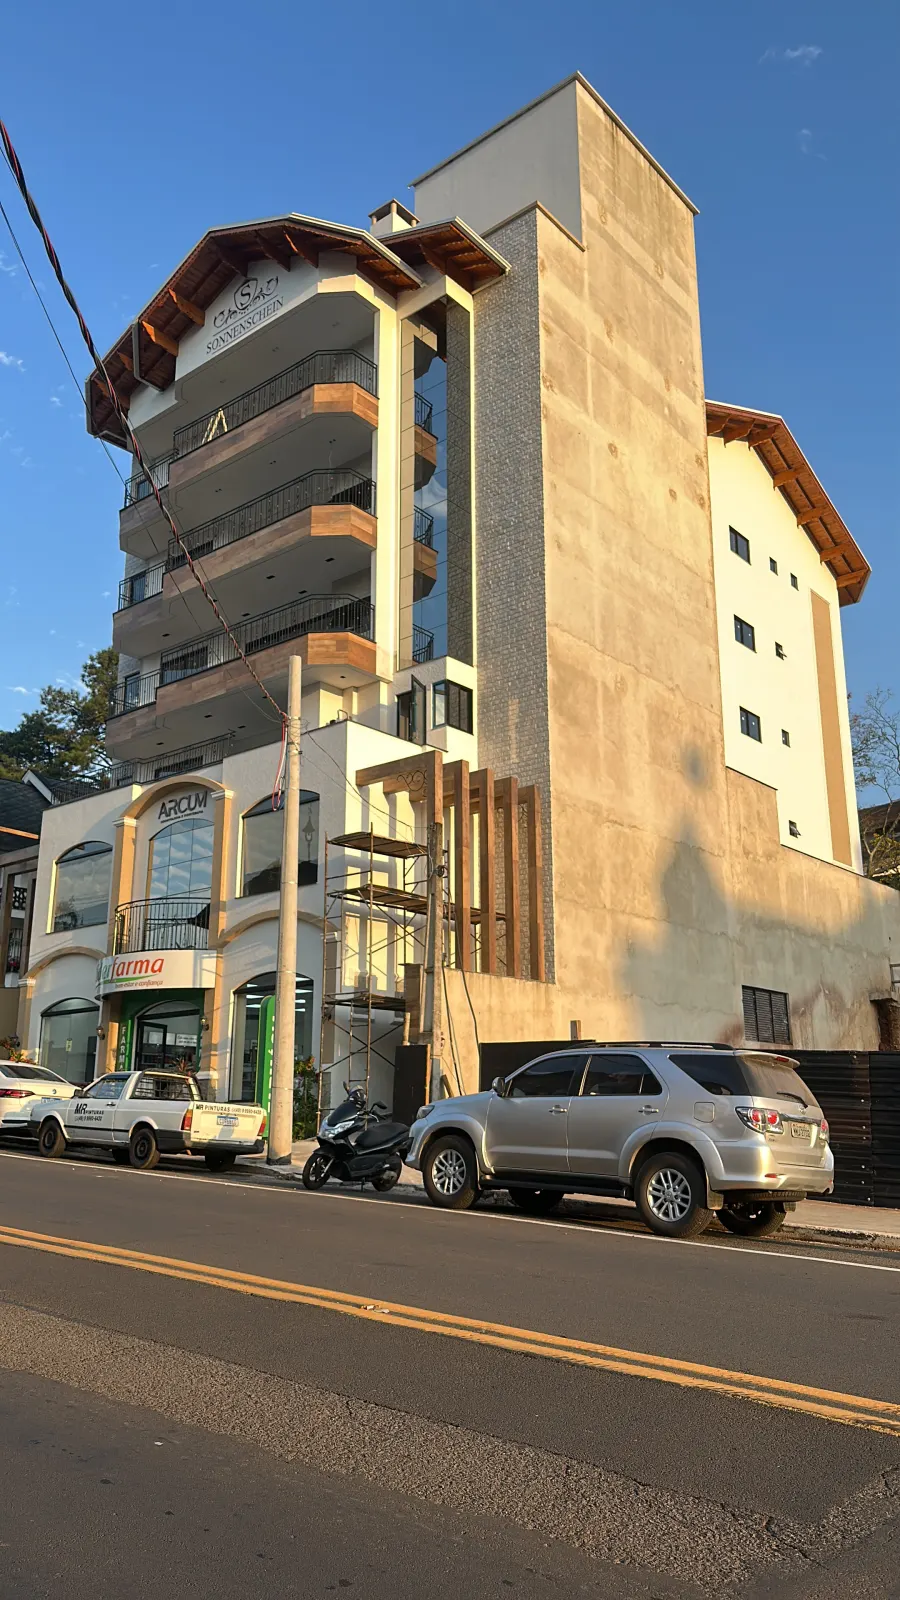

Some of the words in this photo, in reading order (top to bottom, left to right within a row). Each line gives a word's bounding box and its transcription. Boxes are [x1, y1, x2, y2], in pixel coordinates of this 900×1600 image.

[206, 297, 284, 354] SONNENSCHEIN
[158, 790, 208, 819] ARCUM
[74, 1103, 87, 1114] MR
